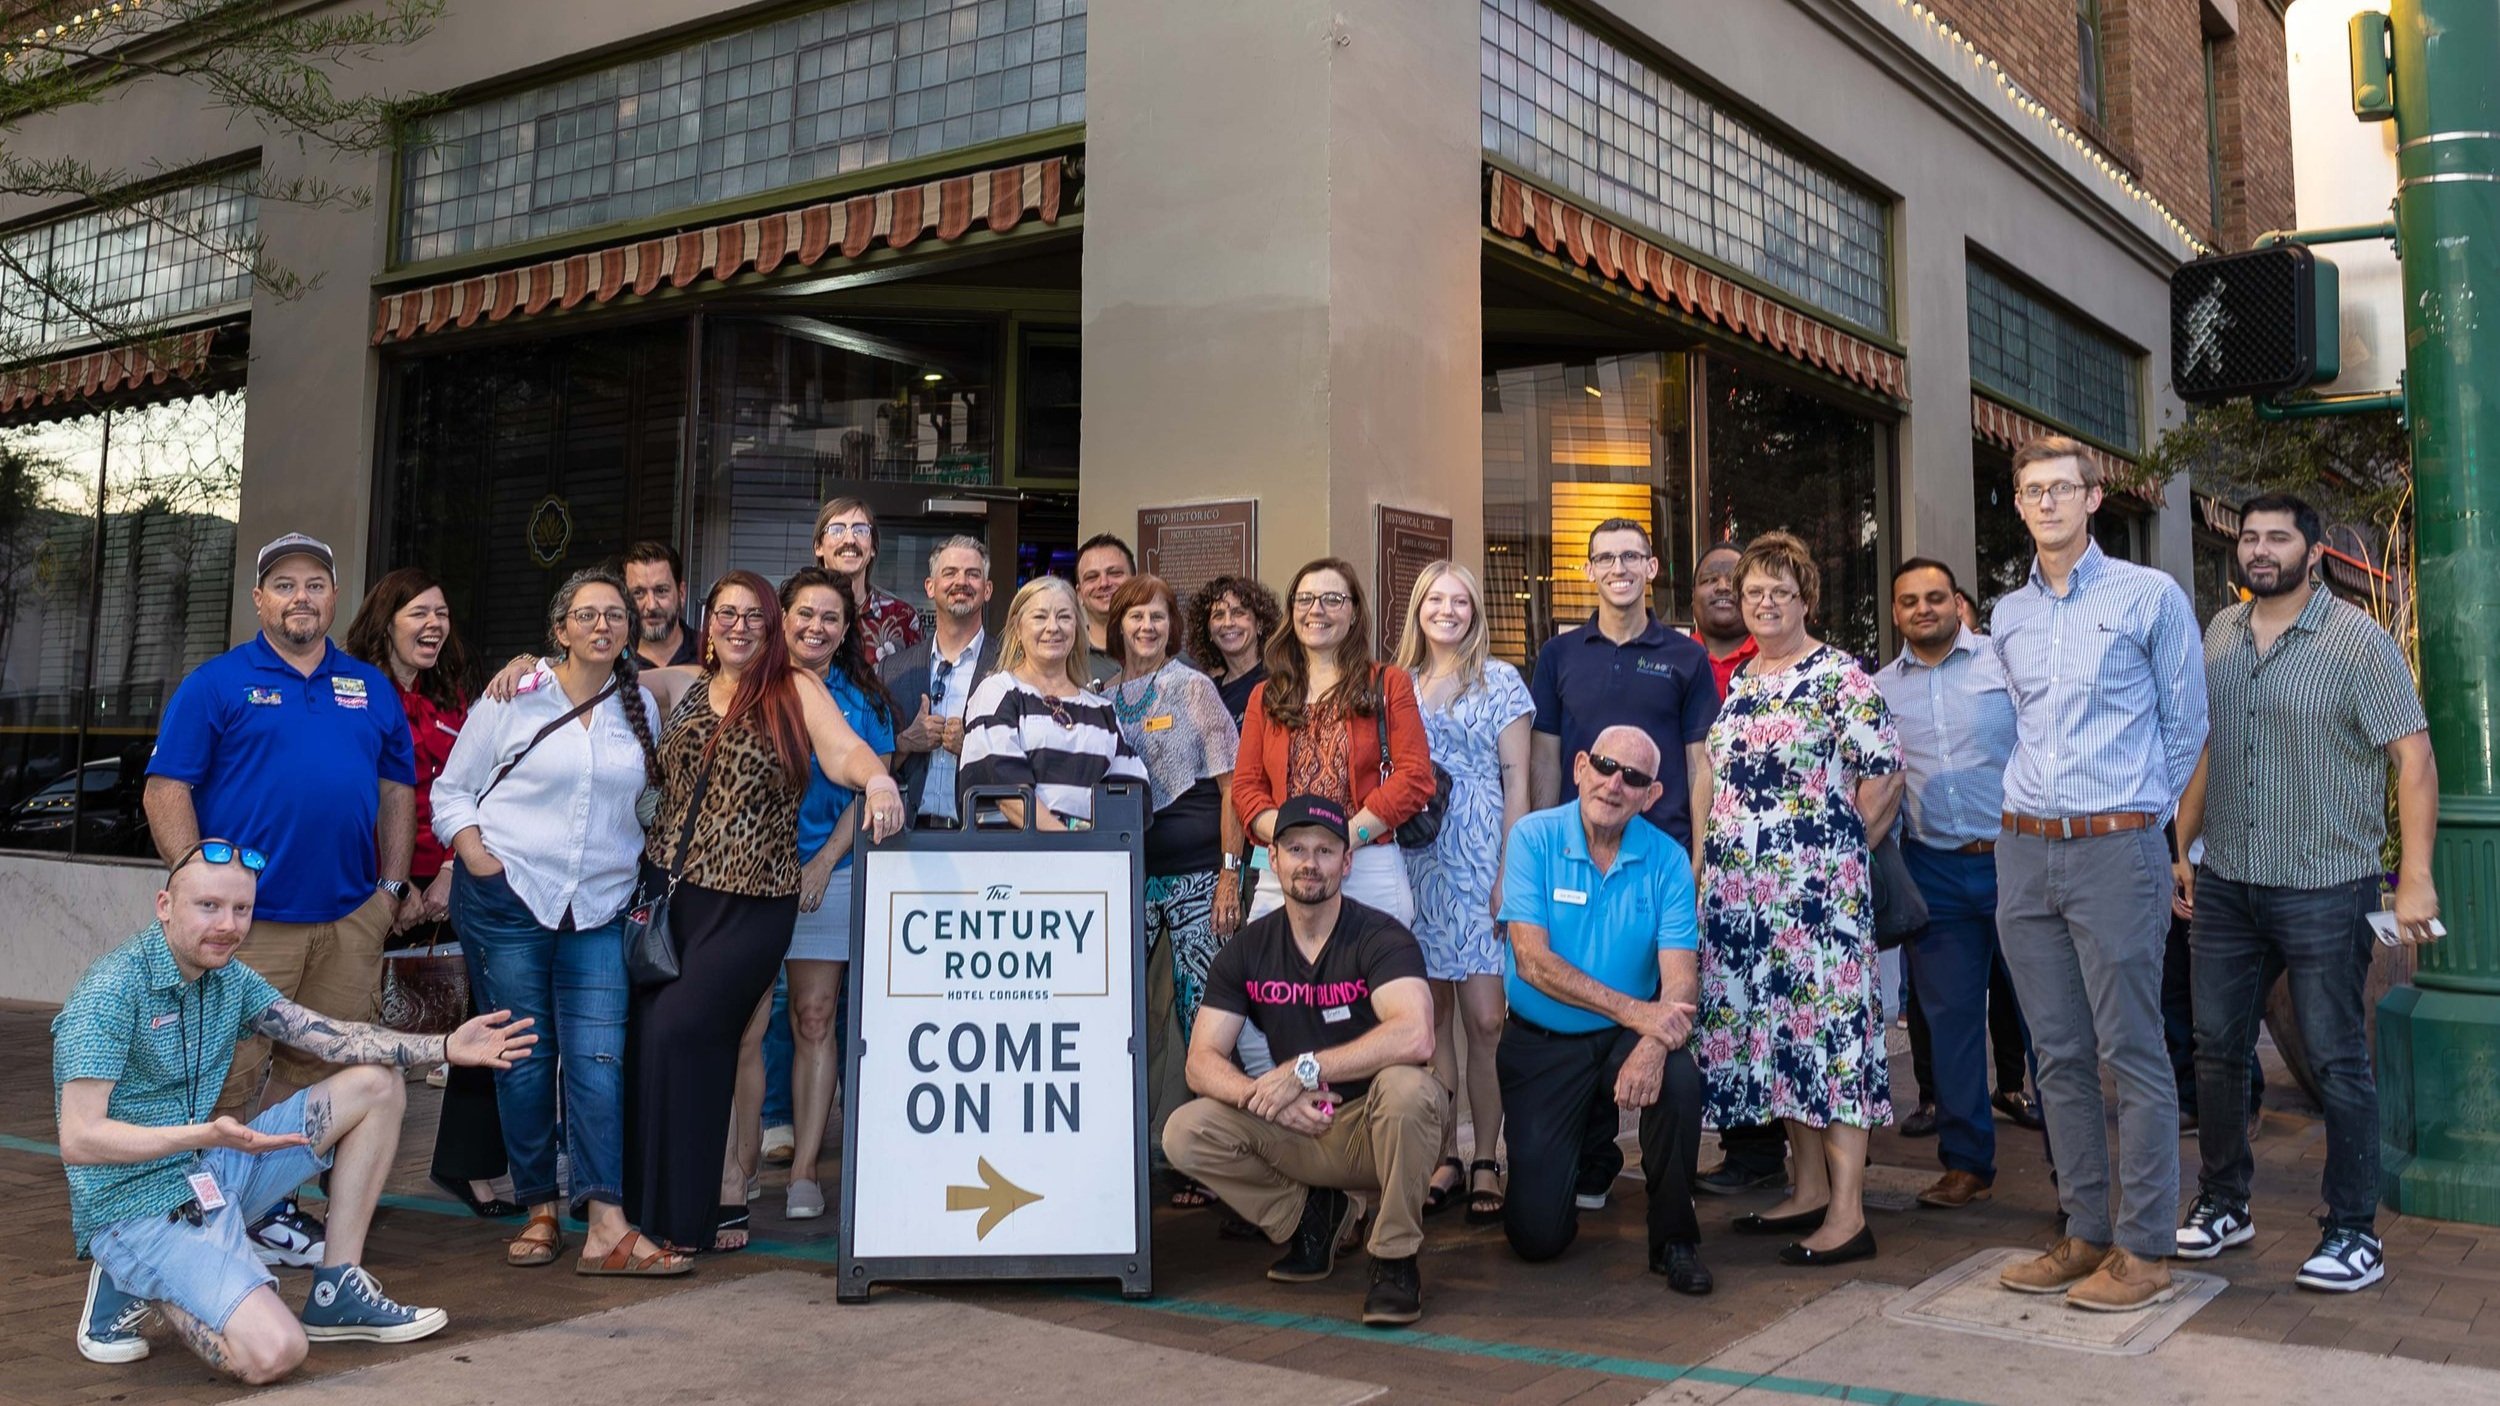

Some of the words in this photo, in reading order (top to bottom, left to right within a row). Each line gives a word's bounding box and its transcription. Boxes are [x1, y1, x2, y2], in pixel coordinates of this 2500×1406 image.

[1144, 513, 1168, 525] SITIO
[1385, 511, 1420, 529] HISTORICAL
[1421, 519, 1435, 531] SITE
[1170, 529, 1193, 540] HOTEL
[1195, 527, 1232, 538] CONGRESS
[986, 884, 1013, 901] The
[902, 909, 1095, 955] CENTURY
[945, 951, 1052, 979] ROOM
[948, 990, 984, 1000] HOTEL
[989, 990, 1049, 1000] CONGRESS
[1316, 979, 1369, 1006] BLINDS
[908, 1022, 1080, 1073] COME
[906, 1082, 990, 1134] ON
[1023, 1082, 1080, 1133] IN
